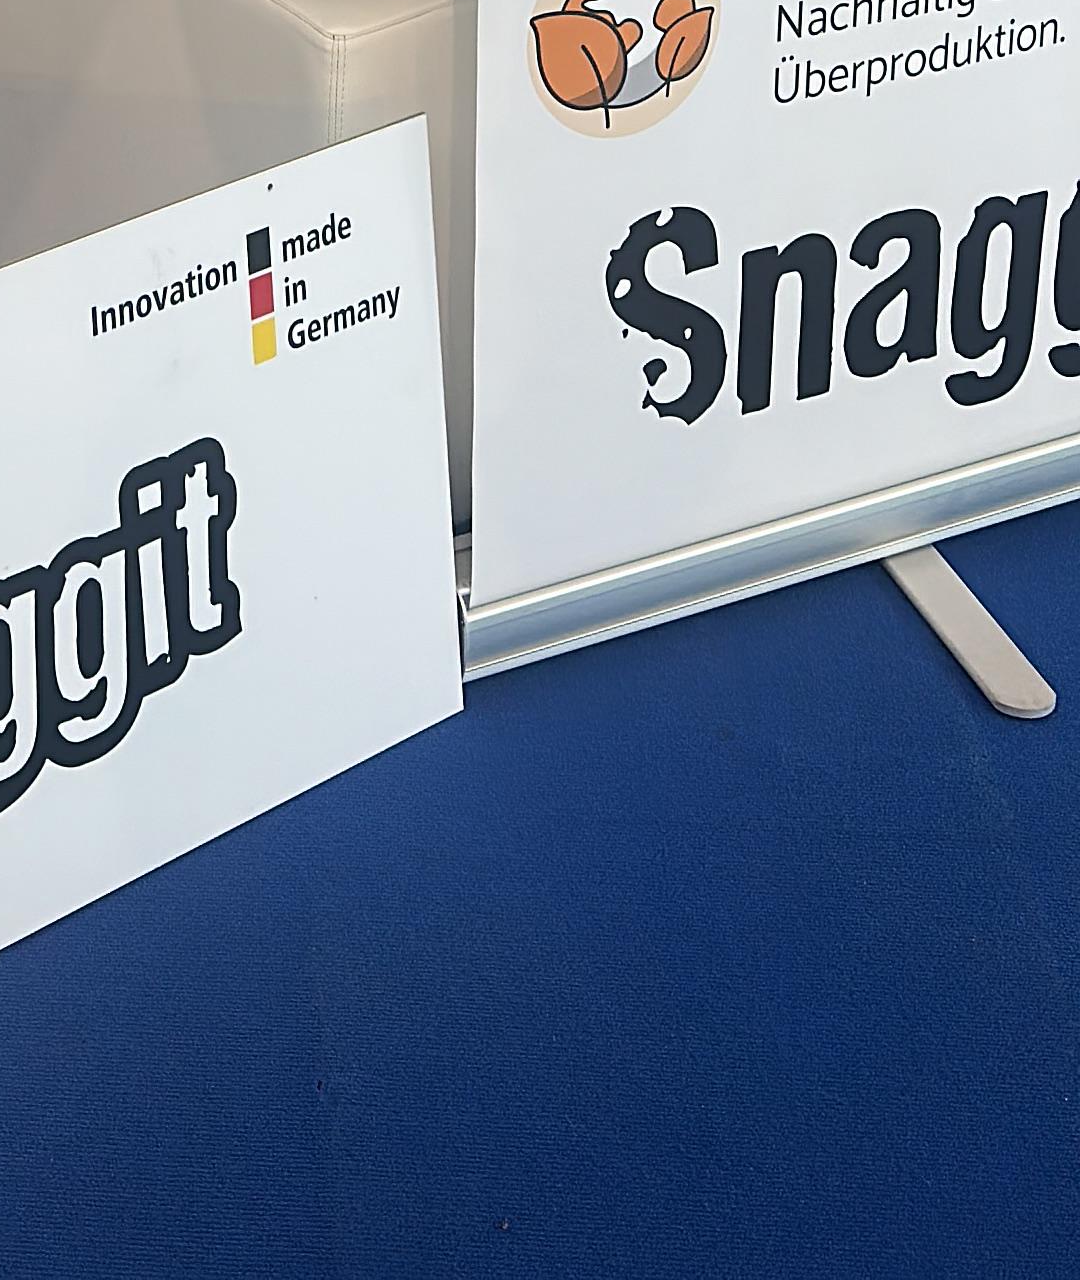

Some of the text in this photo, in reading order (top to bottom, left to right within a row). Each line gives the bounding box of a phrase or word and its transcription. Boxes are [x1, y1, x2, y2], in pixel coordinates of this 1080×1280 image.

[773, 18, 1066, 105] Überproduktion.
[281, 213, 353, 262] made
[90, 258, 238, 337] Innovation
[284, 276, 308, 307] in
[287, 286, 401, 349] Germany
